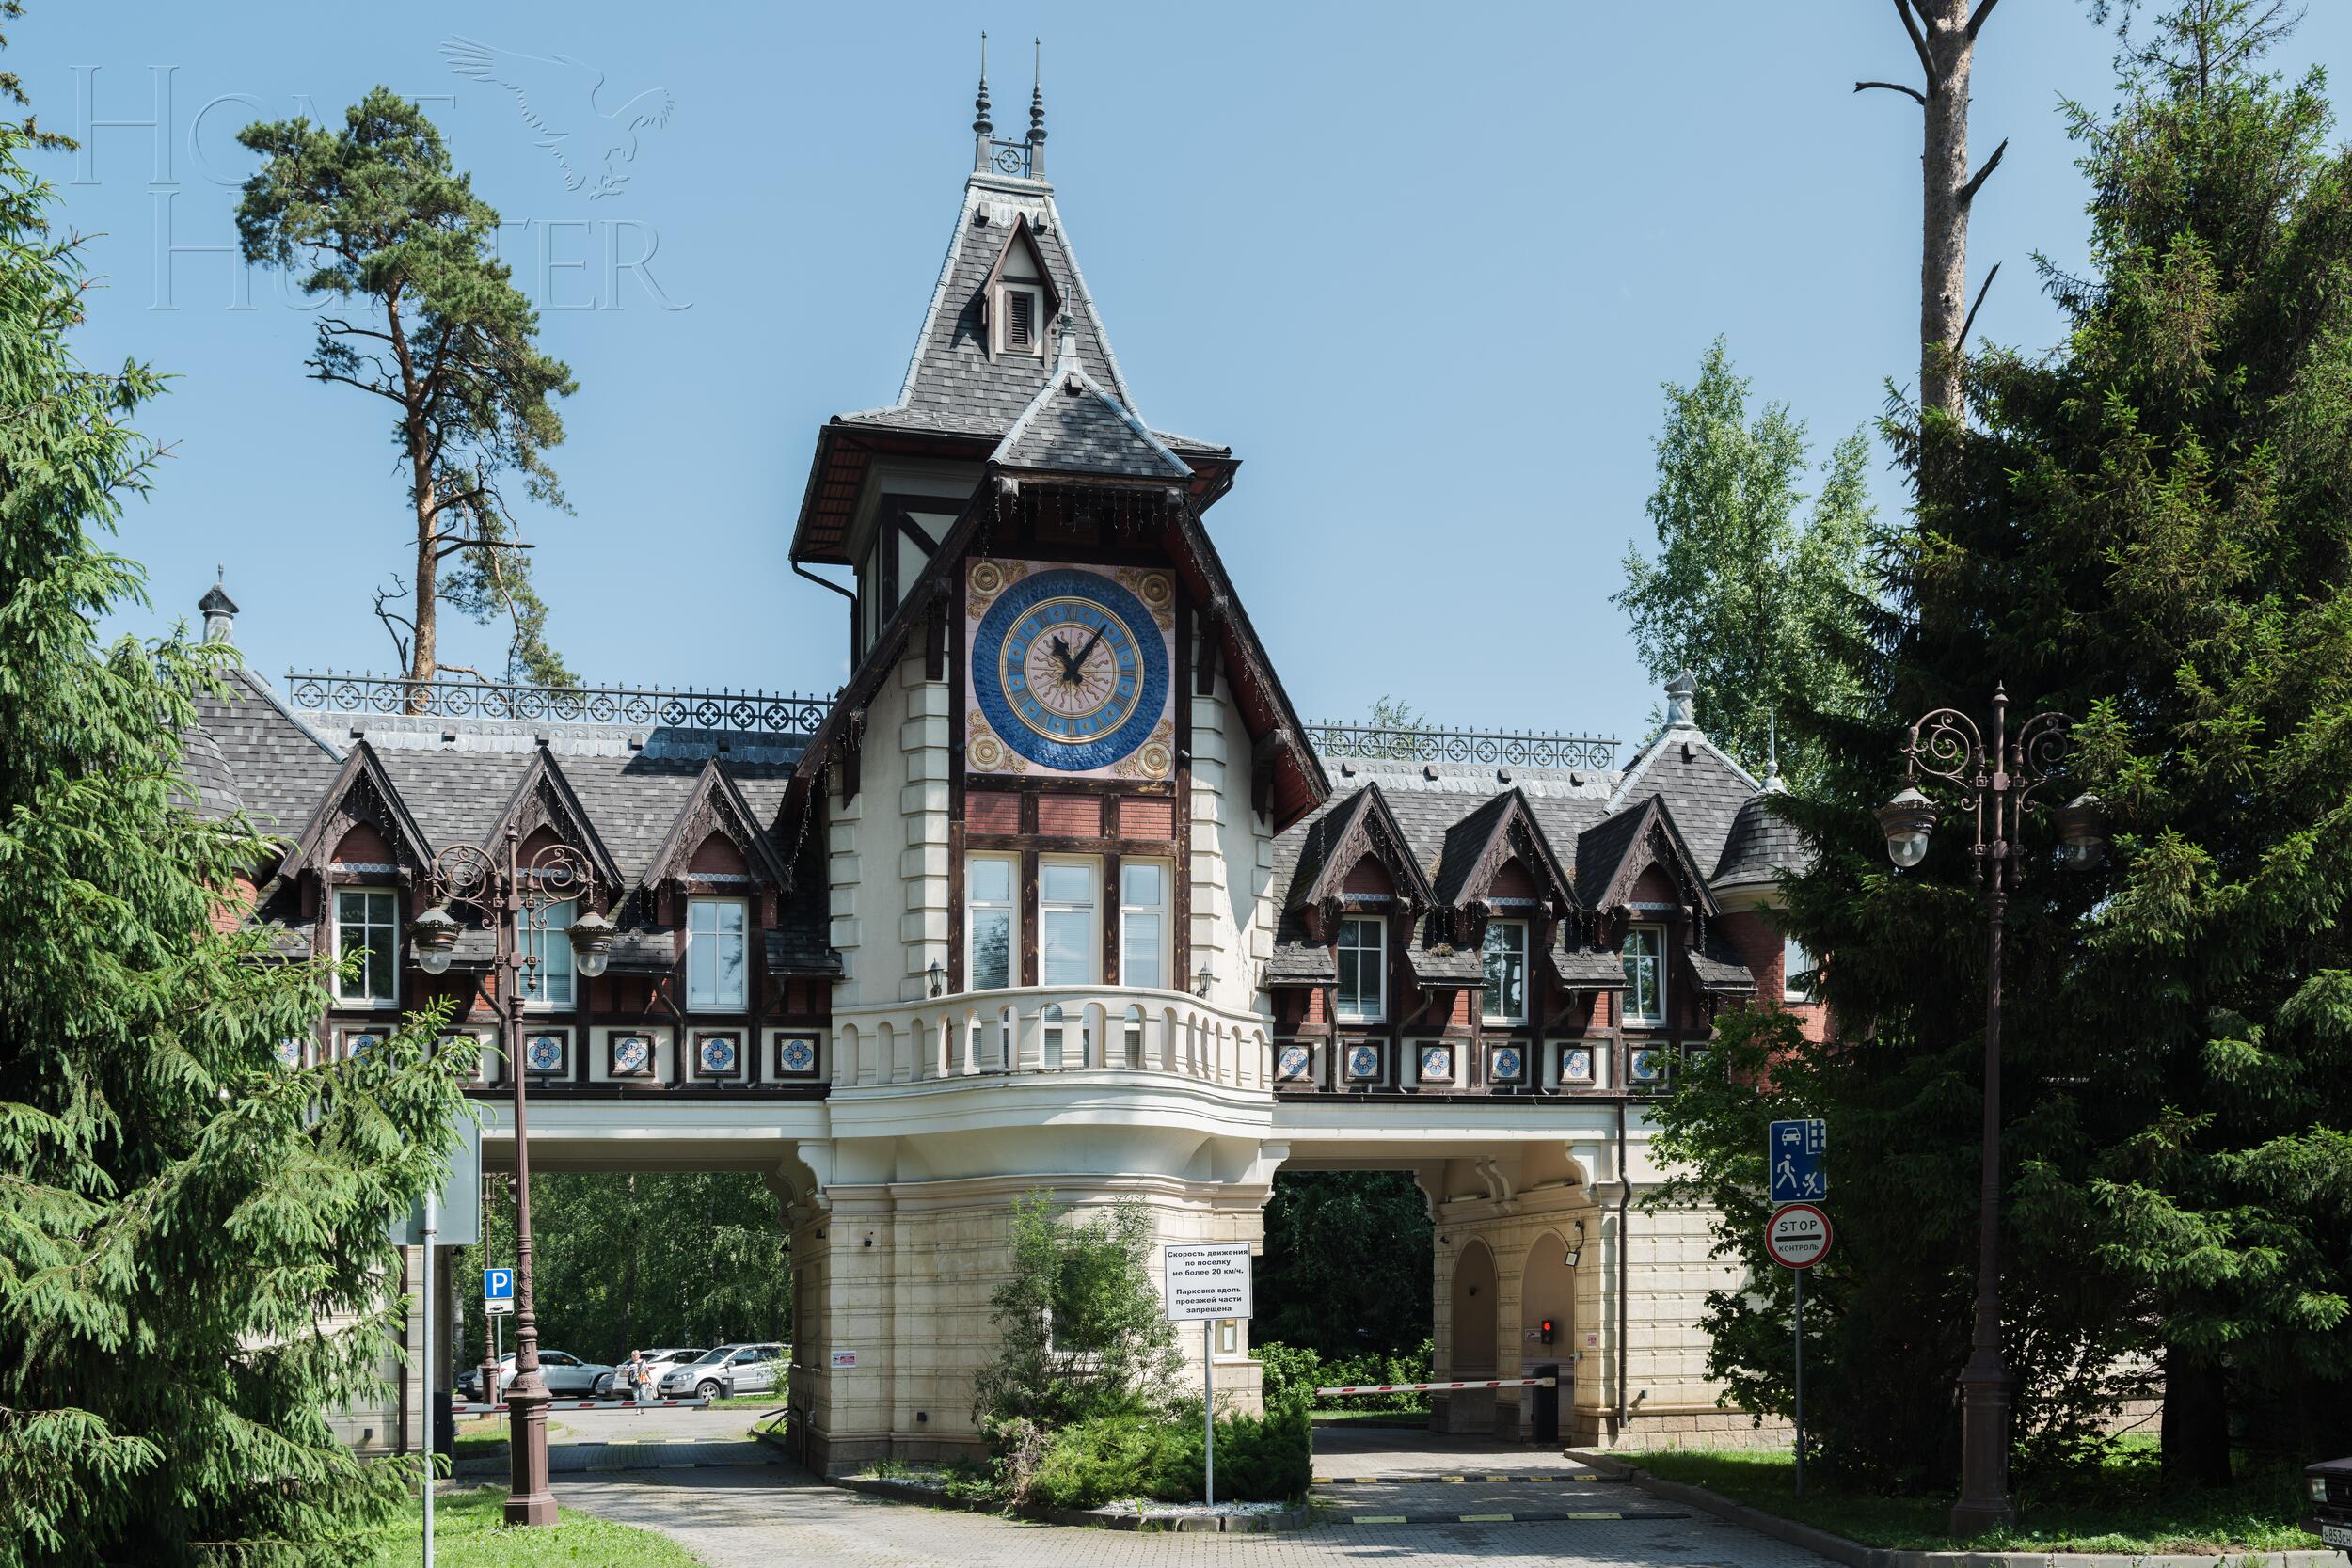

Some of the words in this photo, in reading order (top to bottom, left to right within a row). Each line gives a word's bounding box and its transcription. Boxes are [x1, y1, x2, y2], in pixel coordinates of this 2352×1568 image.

[1780, 1220, 1818, 1232] STOP
[1778, 1243, 1819, 1252] КОНТРОЛЬ
[492, 1272, 508, 1296] P
